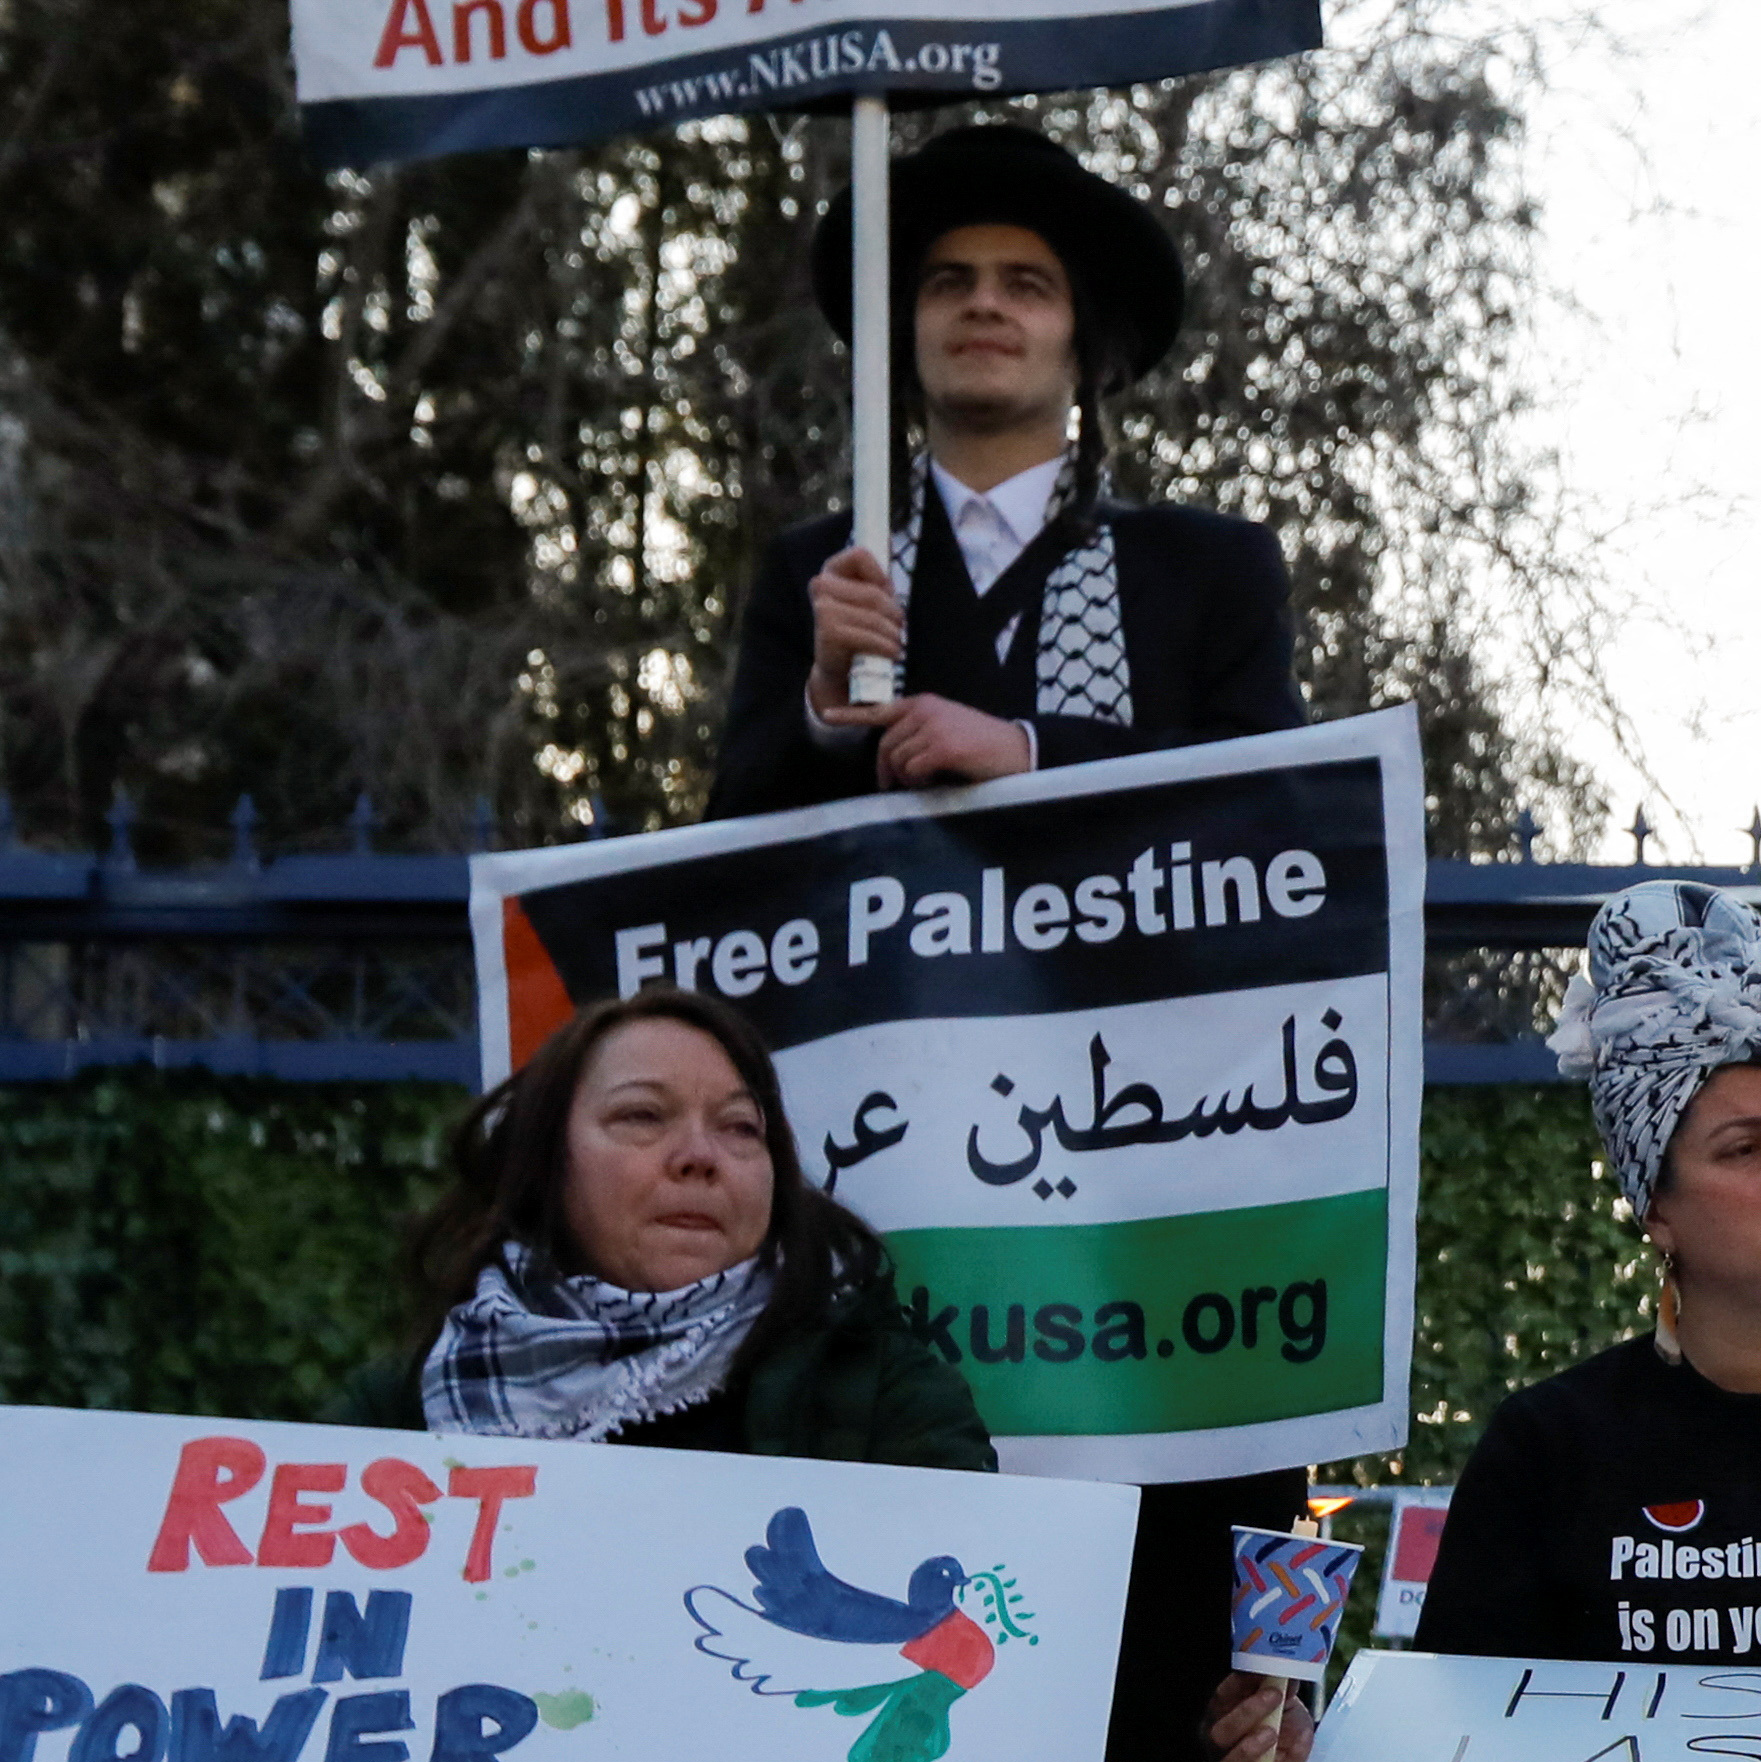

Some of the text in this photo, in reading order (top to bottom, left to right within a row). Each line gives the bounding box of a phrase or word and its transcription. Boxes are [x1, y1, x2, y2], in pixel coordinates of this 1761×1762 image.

[373, 0, 572, 68] And
[634, 28, 1001, 116] www.NKUSA.org
[615, 841, 1326, 1001] Free Palestine
[966, 1006, 1358, 1200] فلسطين
[903, 1271, 1327, 1363] kusa.org
[147, 1435, 537, 1583] REST
[259, 1587, 413, 1682] IN
[1618, 1601, 1655, 1652] is
[1666, 1607, 1720, 1651] on
